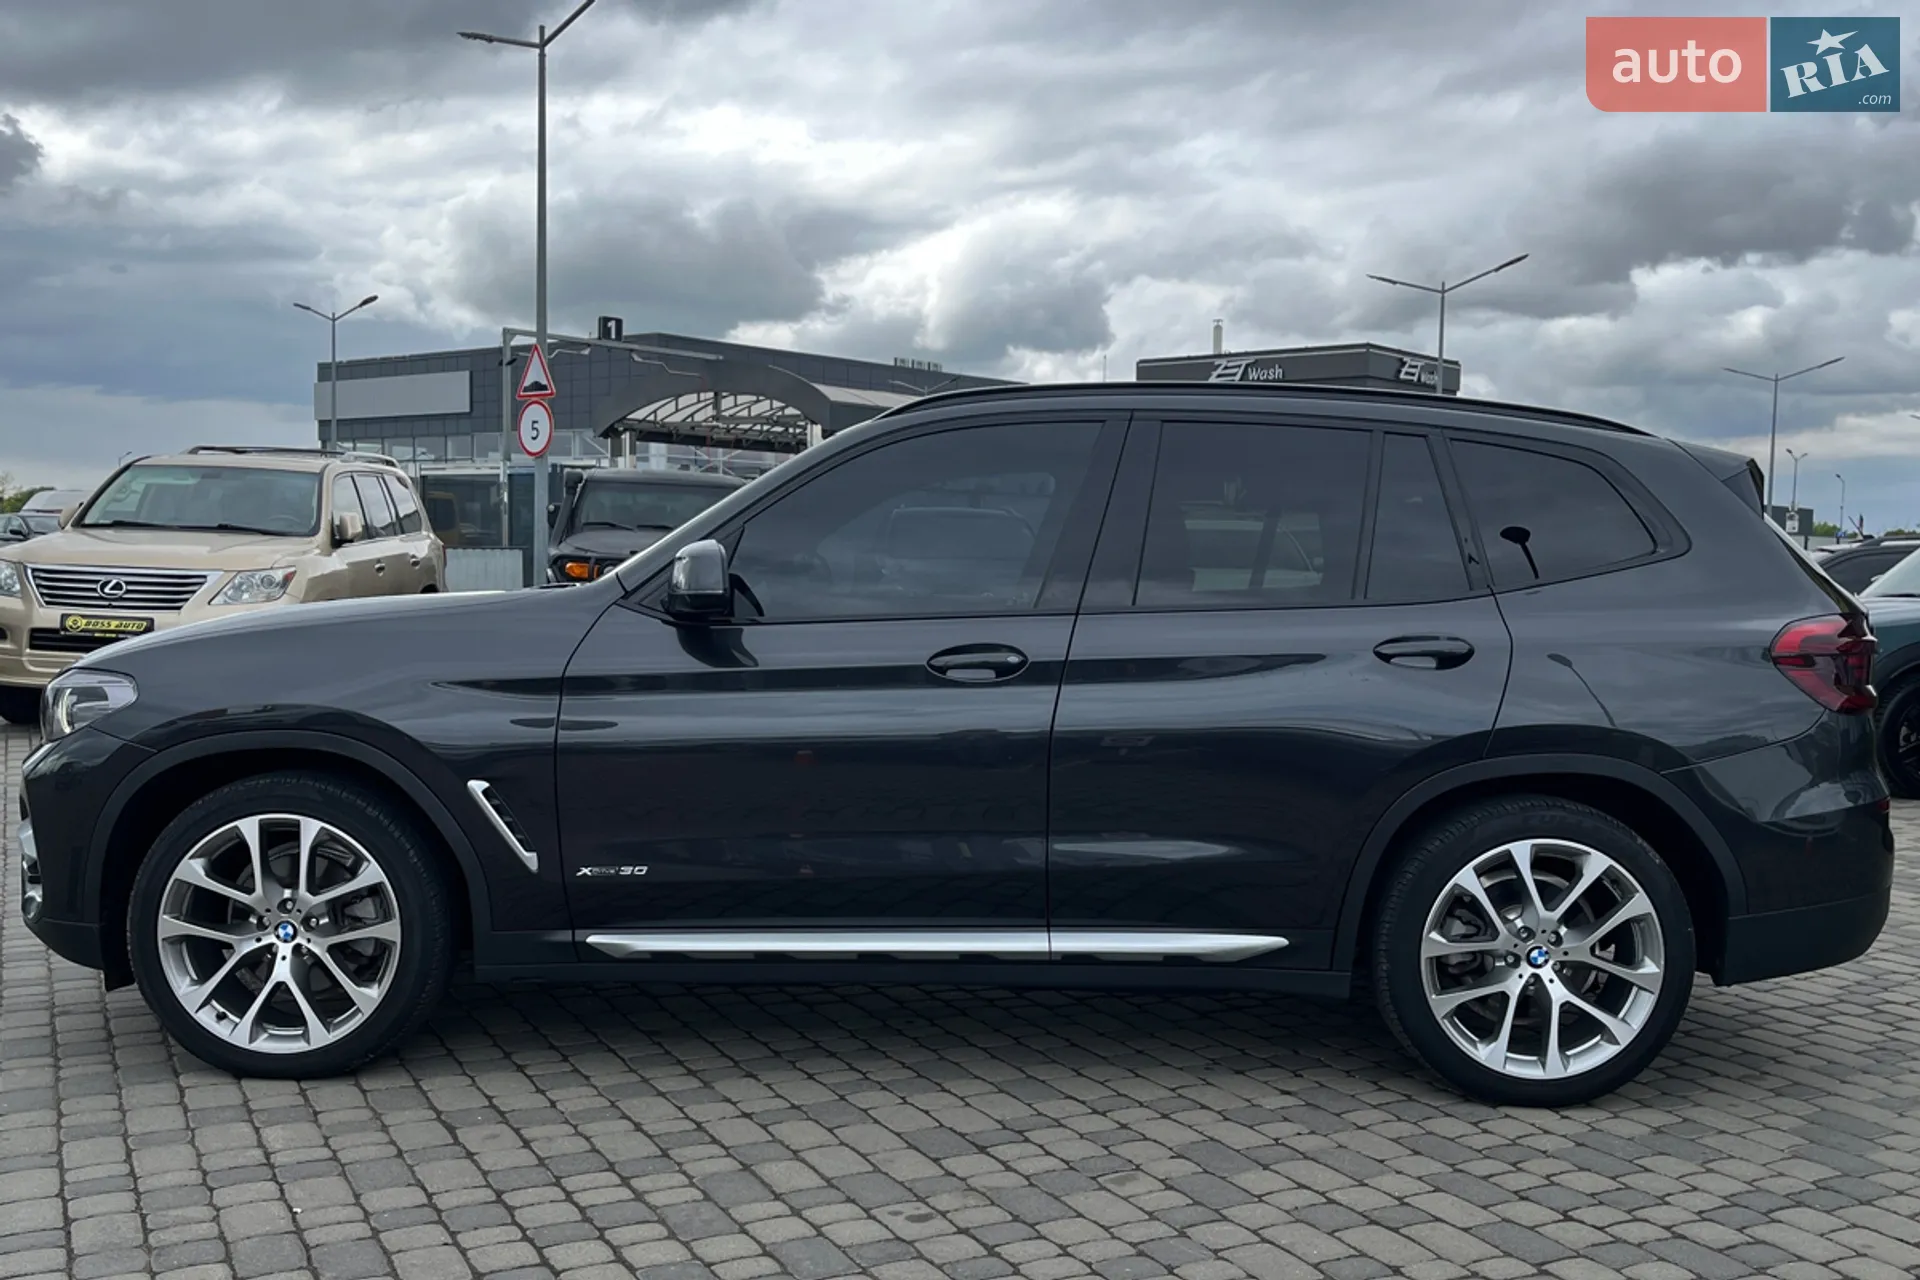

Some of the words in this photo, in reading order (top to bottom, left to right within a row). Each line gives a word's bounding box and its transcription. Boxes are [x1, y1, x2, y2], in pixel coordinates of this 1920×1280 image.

[607, 320, 616, 339] 1
[1248, 363, 1283, 381] Wash
[531, 420, 540, 441] 5
[84, 620, 112, 629] BOSS
[115, 622, 144, 630] AUTO
